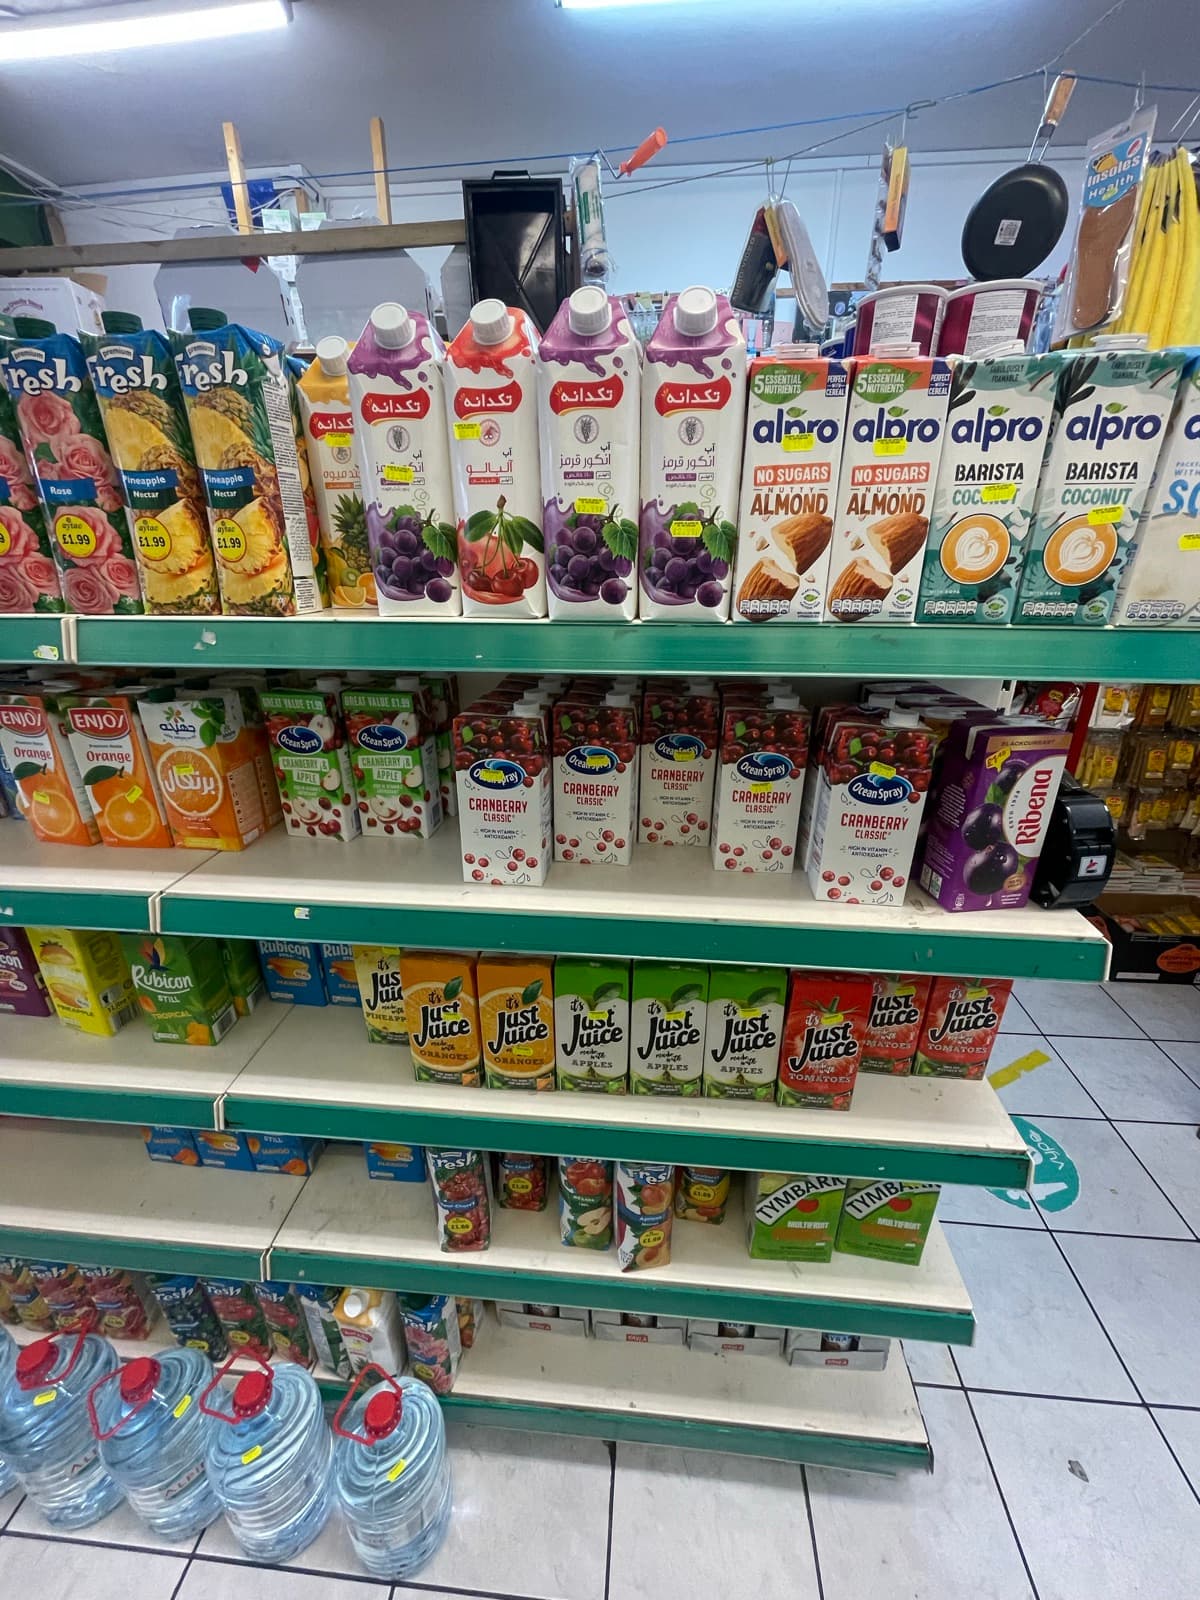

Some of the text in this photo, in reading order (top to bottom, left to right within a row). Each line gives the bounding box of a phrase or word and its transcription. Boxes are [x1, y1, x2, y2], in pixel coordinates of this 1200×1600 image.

[1088, 156, 1140, 187] Insoles
[1089, 175, 1133, 200] Health
[990, 364, 1024, 374] FABULOUSLY
[1111, 361, 1145, 370] FABULOUSLY
[827, 375, 846, 383] PERFECT
[931, 375, 950, 383] PERFECT
[992, 374, 1018, 383] FOAMABLE
[1112, 371, 1139, 379] FOAMABLE
[754, 375, 802, 394] 5 ESSENTIAL
[764, 385, 800, 394] NUTRIENTS
[857, 374, 904, 393] 5 ESSENTIAL
[867, 384, 904, 393] NUTRIENTS
[560, 389, 613, 403] تکدانه
[666, 391, 721, 405] تکدانه
[929, 388, 948, 396] CEREAL
[371, 400, 421, 415] تکدانه
[464, 392, 513, 409] تکدانه
[318, 417, 355, 429] کدانه
[753, 408, 839, 443] alpro
[853, 407, 940, 443] alpro
[951, 407, 1044, 452] alpro
[1066, 403, 1162, 450] alpro
[560, 454, 580, 469] قرمز
[662, 456, 684, 471] قرمز
[205, 474, 244, 483] Pineapple
[756, 466, 828, 483] NO SUGARS
[854, 466, 927, 483] NO SUGARS
[955, 462, 1024, 482] BARISTA
[1065, 462, 1138, 481] BARISTA
[123, 475, 167, 486] Pineapple
[50, 486, 72, 495] Rose
[1061, 488, 1132, 505] COCONUT
[750, 493, 828, 516] ALMOND
[846, 493, 925, 515] ALMOND
[62, 534, 90, 545] £1.99
[139, 536, 166, 547] £1.99
[218, 537, 241, 548] £1.99
[281, 734, 319, 750] Ocean Spray
[361, 733, 402, 748] Ocean Spray
[14, 746, 52, 761] Orange
[87, 751, 131, 763] Orange
[282, 758, 318, 769] CRANBERRY
[361, 758, 401, 767] CRANBERRY
[740, 762, 785, 778] Ocean Spray
[296, 771, 317, 782] APPLE
[377, 769, 398, 781] APPLE
[651, 768, 704, 782] CRANBERRY
[563, 782, 619, 797] CRANBERRY
[732, 790, 791, 804] CRANBERRY
[852, 782, 903, 801] Ocean Spray
[469, 798, 528, 813] CRANBERRY
[1016, 769, 1053, 845] Ribena
[841, 813, 909, 830] CRANBERRY
[259, 940, 311, 959] Rubicon
[131, 964, 193, 990] Rubicon
[158, 994, 181, 1003] STILL
[152, 1010, 192, 1018] TROPICAL
[366, 1012, 407, 1022] PINEAPP
[414, 1001, 460, 1038] Just
[930, 996, 994, 1031] Just
[488, 1005, 540, 1044] Just
[562, 1008, 616, 1046] Just
[637, 1011, 693, 1050] Just
[711, 1013, 770, 1053] Just
[790, 1022, 852, 1064] Just
[865, 1040, 911, 1049] MATOES
[626, 1169, 671, 1184] Fres
[756, 1176, 845, 1221] TYMBARK
[846, 1182, 941, 1215] TYMB
[152, 1287, 194, 1300] resh
[203, 1283, 242, 1296] resh
